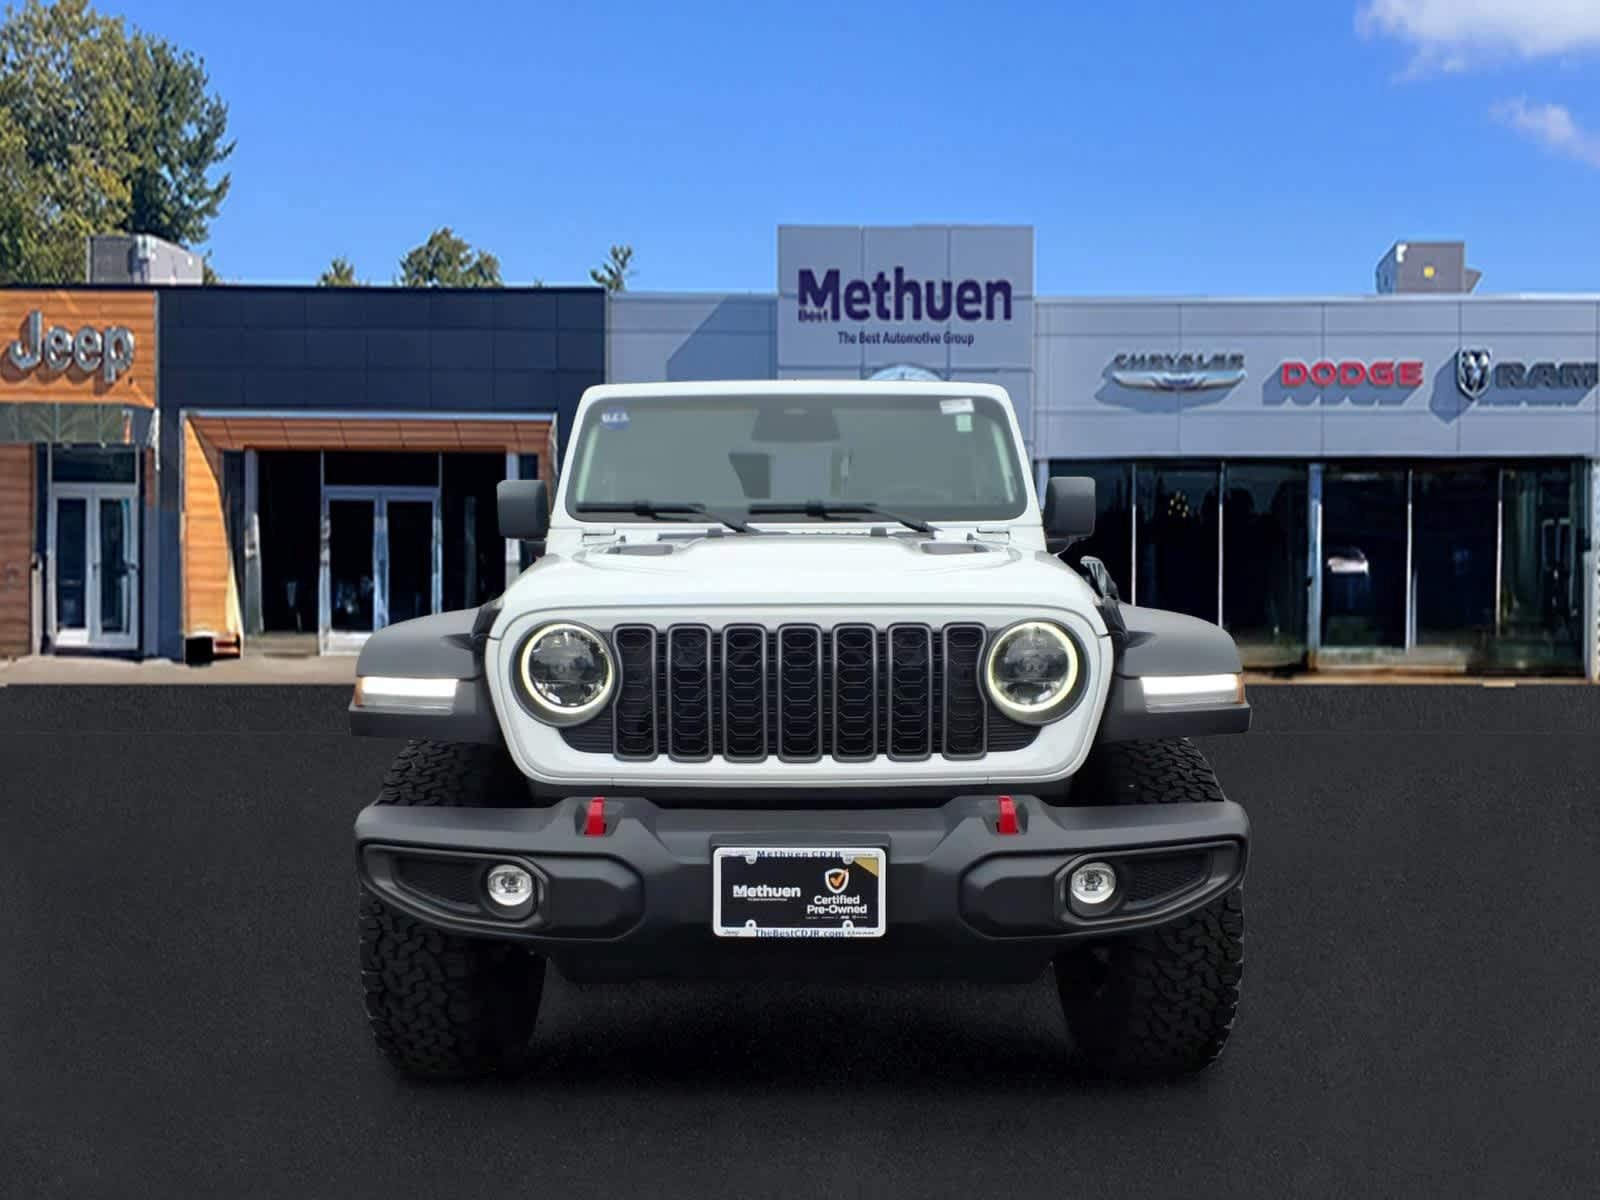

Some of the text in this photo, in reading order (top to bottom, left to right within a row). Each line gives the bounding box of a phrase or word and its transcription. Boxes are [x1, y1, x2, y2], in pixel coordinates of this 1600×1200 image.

[798, 266, 1012, 322] Methuen
[838, 330, 974, 346] The Best Automotive Group
[9, 310, 135, 384] Jeep
[1113, 353, 1245, 369] CHRYSLER
[1281, 361, 1424, 388] DODGE
[1496, 361, 1599, 388] RAM
[756, 850, 808, 858] Methuen
[811, 850, 841, 858] CDJR
[732, 884, 801, 898] Methuen
[814, 895, 860, 905] Certified
[807, 904, 868, 914] Pre-Owned
[755, 929, 844, 938] TheBestCDJR.com
